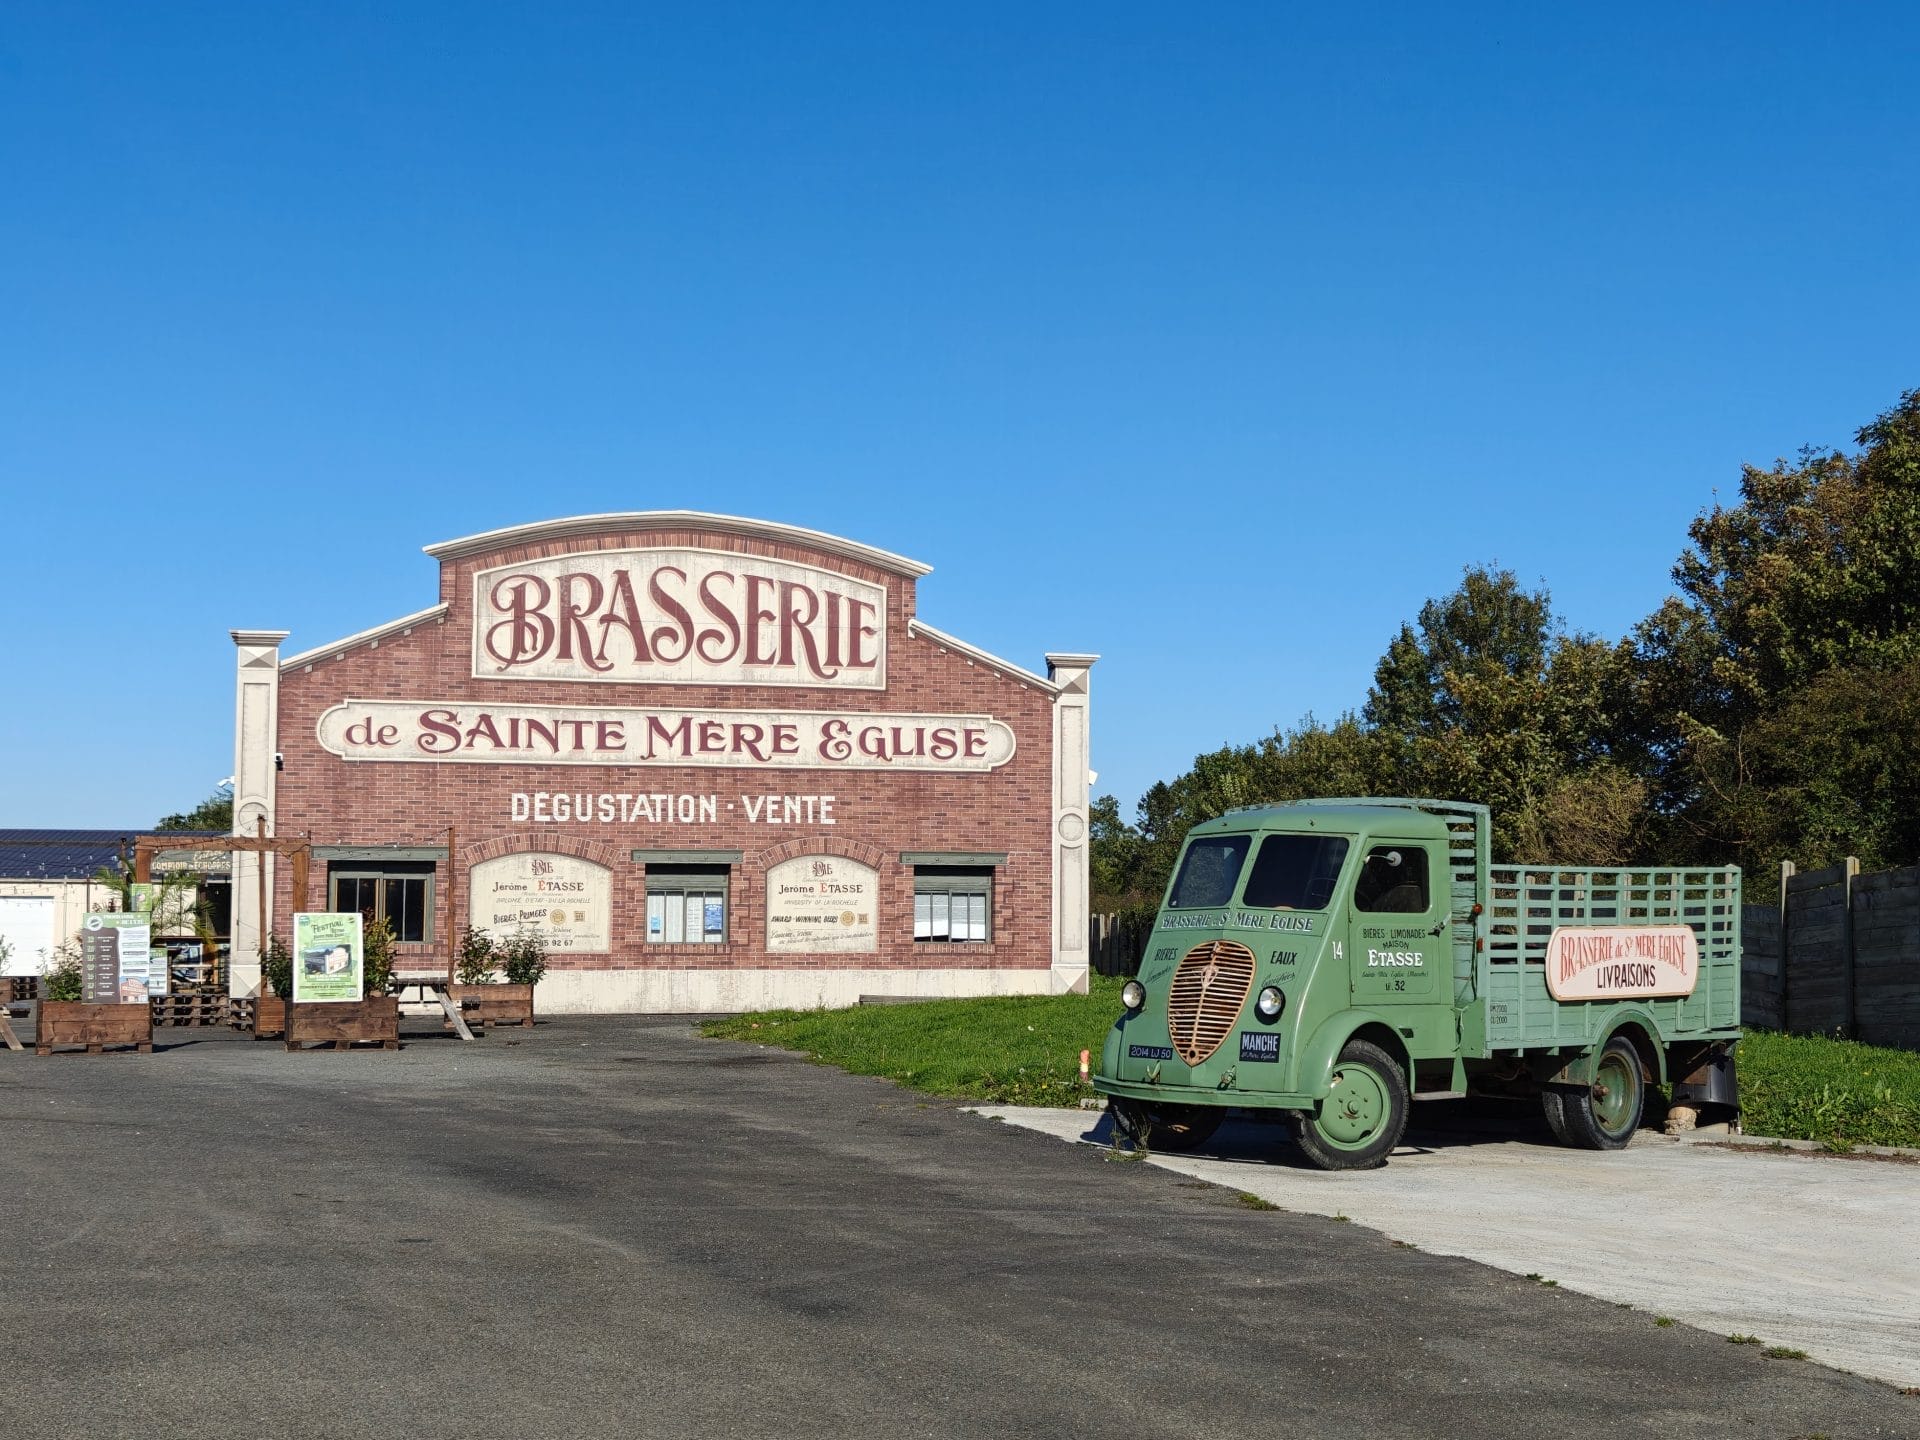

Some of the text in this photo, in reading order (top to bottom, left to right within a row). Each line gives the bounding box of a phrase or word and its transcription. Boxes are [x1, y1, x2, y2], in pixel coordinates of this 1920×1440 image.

[485, 566, 877, 680] BRASSERIE
[345, 716, 401, 746] de
[416, 709, 627, 754] SAINTE
[819, 719, 988, 761] EGLISE
[511, 792, 717, 822] DÉGUSTATION
[742, 795, 836, 824] VENTE
[1161, 913, 1211, 929] BRASSERIE
[1390, 928, 1426, 939] LIMONADES
[551, 939, 562, 947] 92
[563, 939, 574, 947] 67
[1332, 940, 1344, 960] 14
[1382, 940, 1410, 949] MAISON
[1270, 950, 1297, 966] EAUX
[1368, 949, 1424, 967] ETASSE
[1559, 936, 1613, 984] BRASSERIE
[1615, 939, 1624, 957] de
[1597, 962, 1656, 989] LIVRAISONS
[1394, 980, 1406, 991] 32
[1241, 1034, 1279, 1051] MANCHE
[1131, 1046, 1171, 1059] 2014 LJ 50
